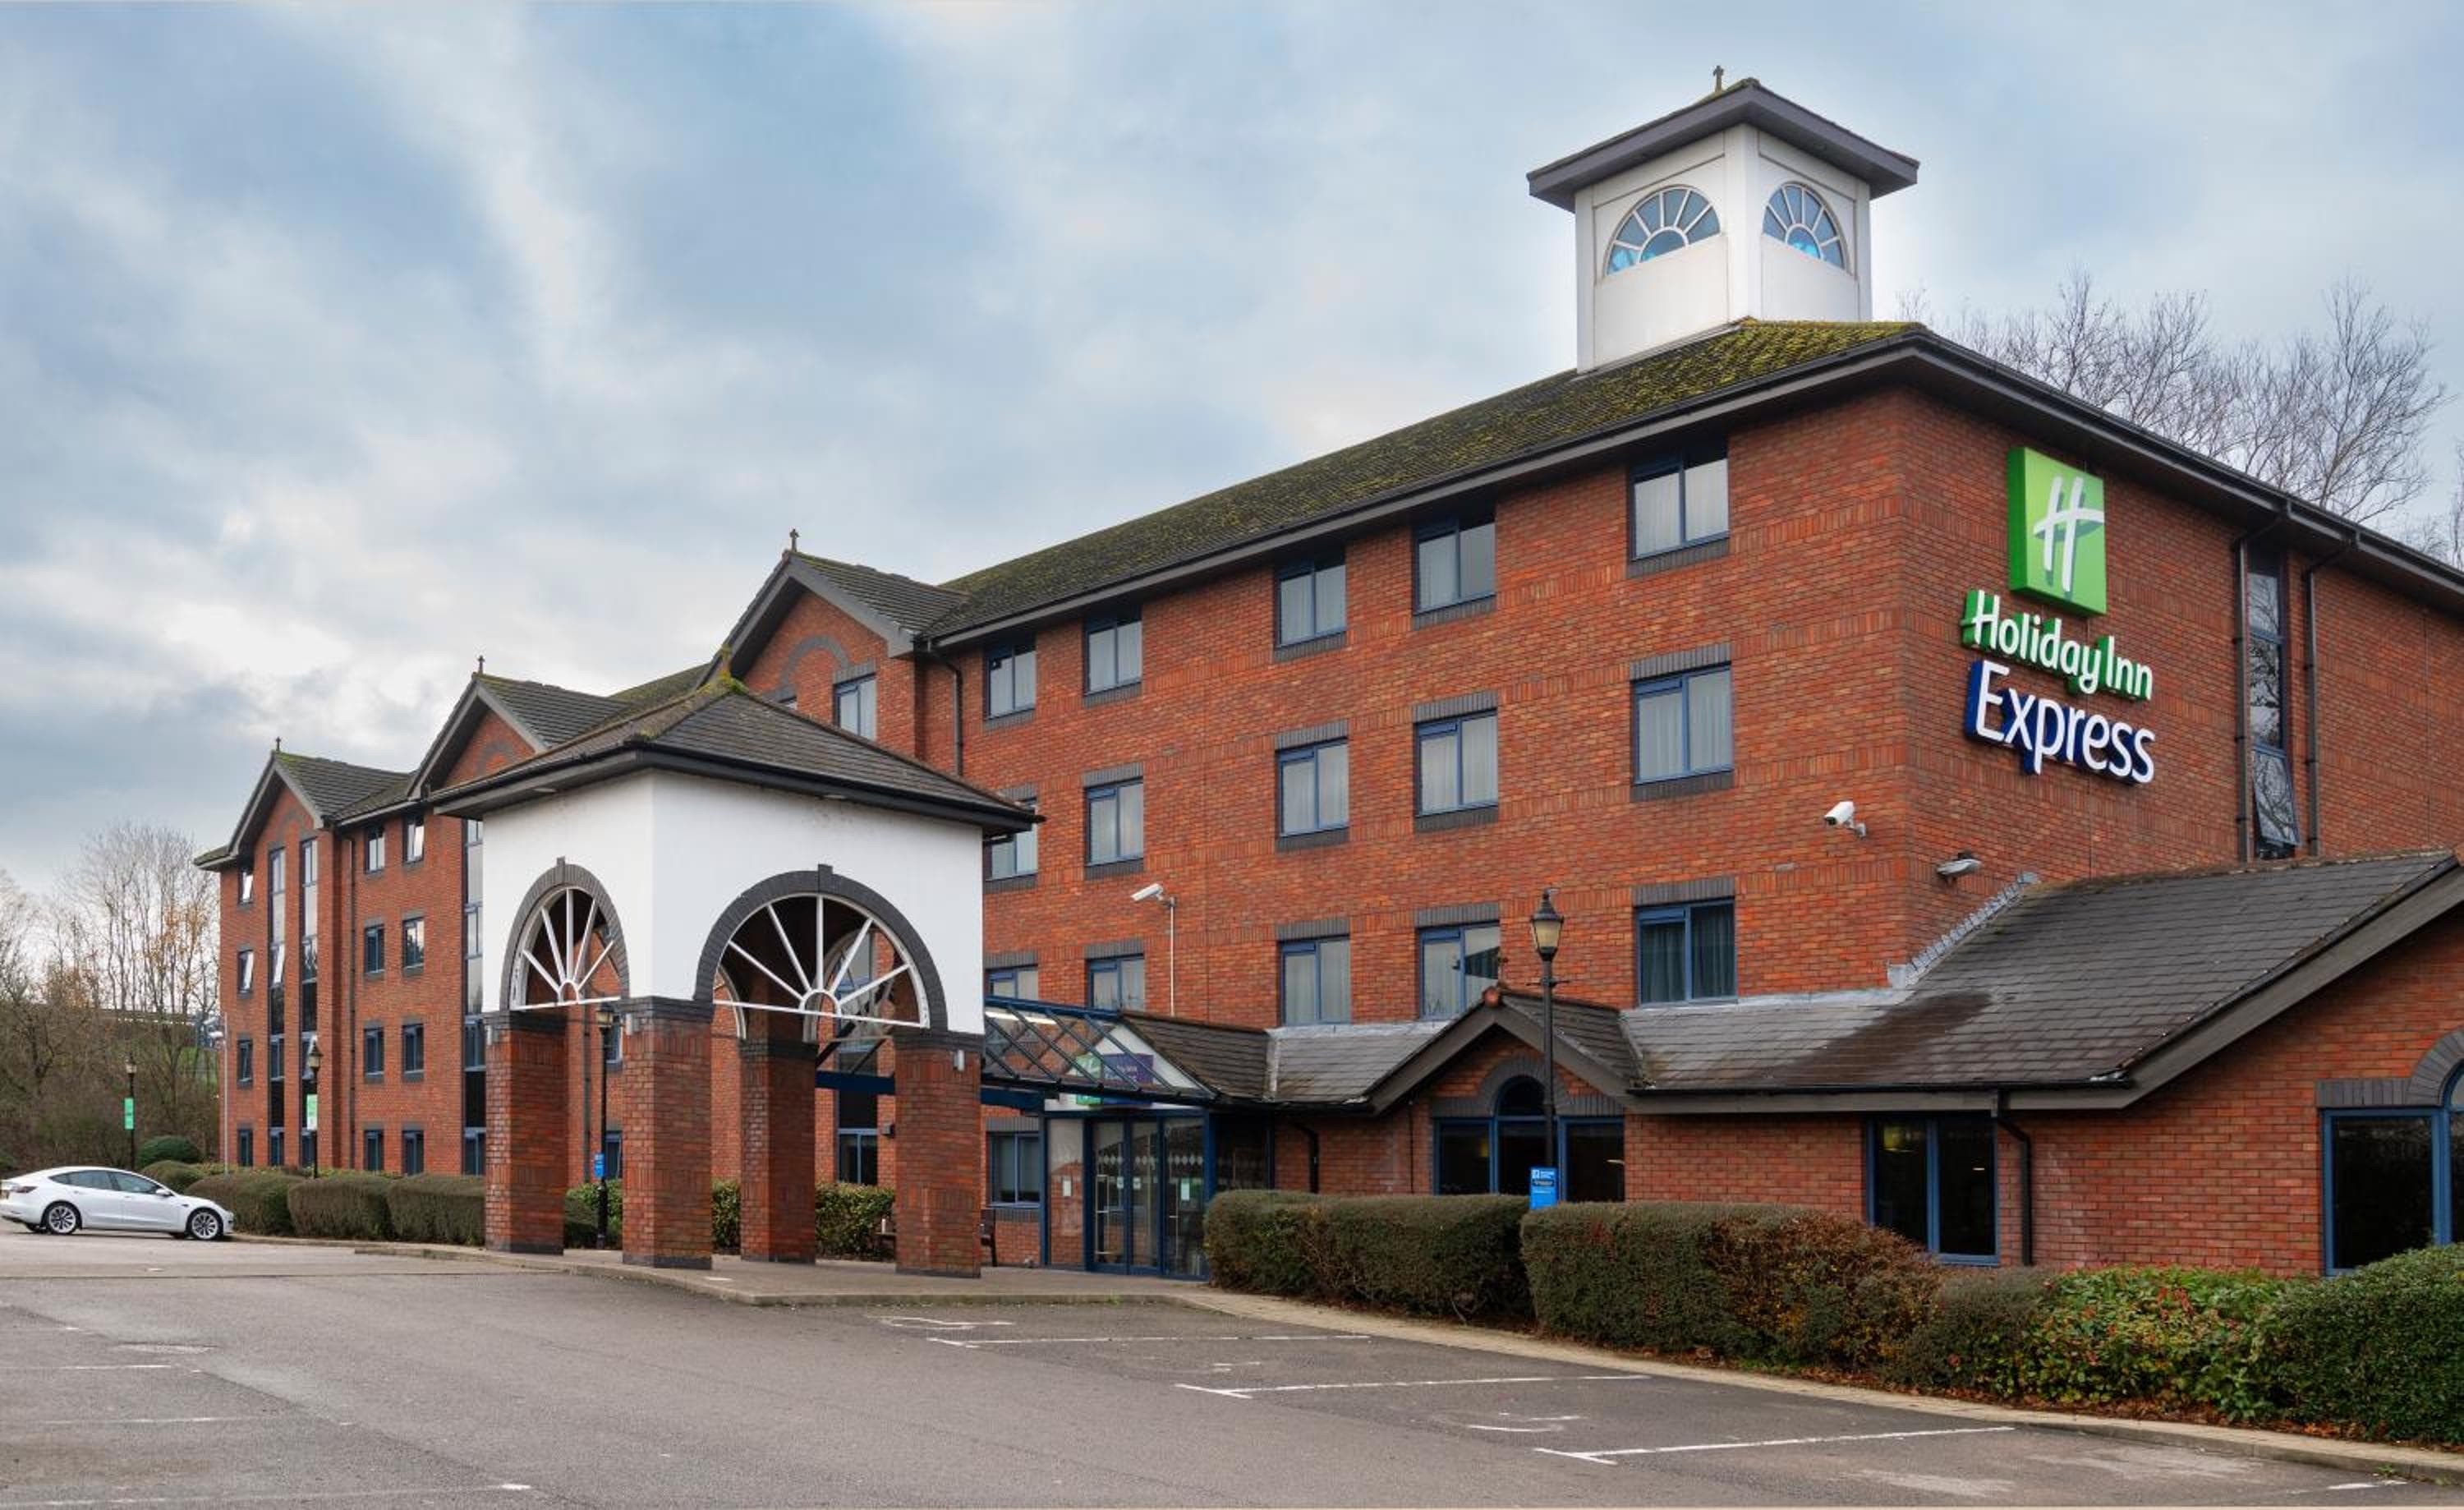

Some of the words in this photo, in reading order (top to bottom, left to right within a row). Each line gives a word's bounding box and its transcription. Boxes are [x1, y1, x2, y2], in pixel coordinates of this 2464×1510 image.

[1971, 590, 2101, 694] Holiday
[2106, 636, 2153, 700] Inn
[1976, 661, 2155, 784] Express
